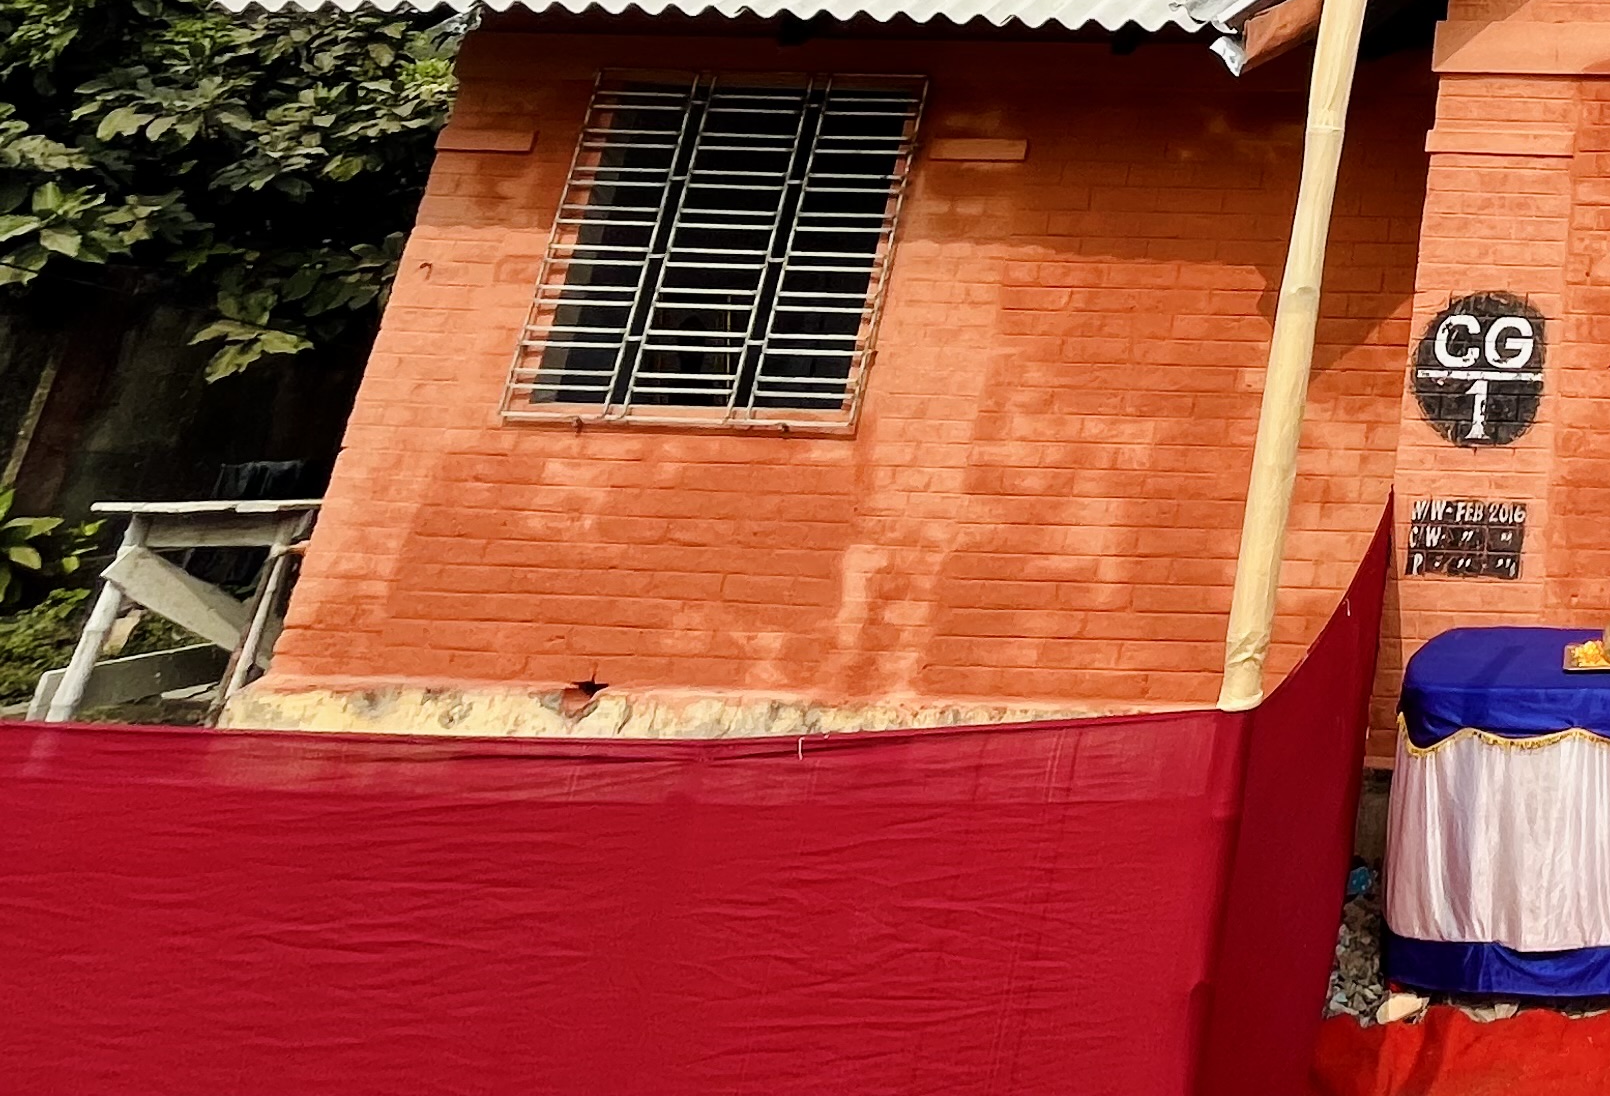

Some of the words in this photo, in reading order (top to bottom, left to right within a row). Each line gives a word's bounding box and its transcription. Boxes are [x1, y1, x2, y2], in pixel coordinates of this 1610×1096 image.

[1434, 314, 1534, 369] CG
[1464, 379, 1490, 440] 1
[1488, 503, 1526, 524] 2016
